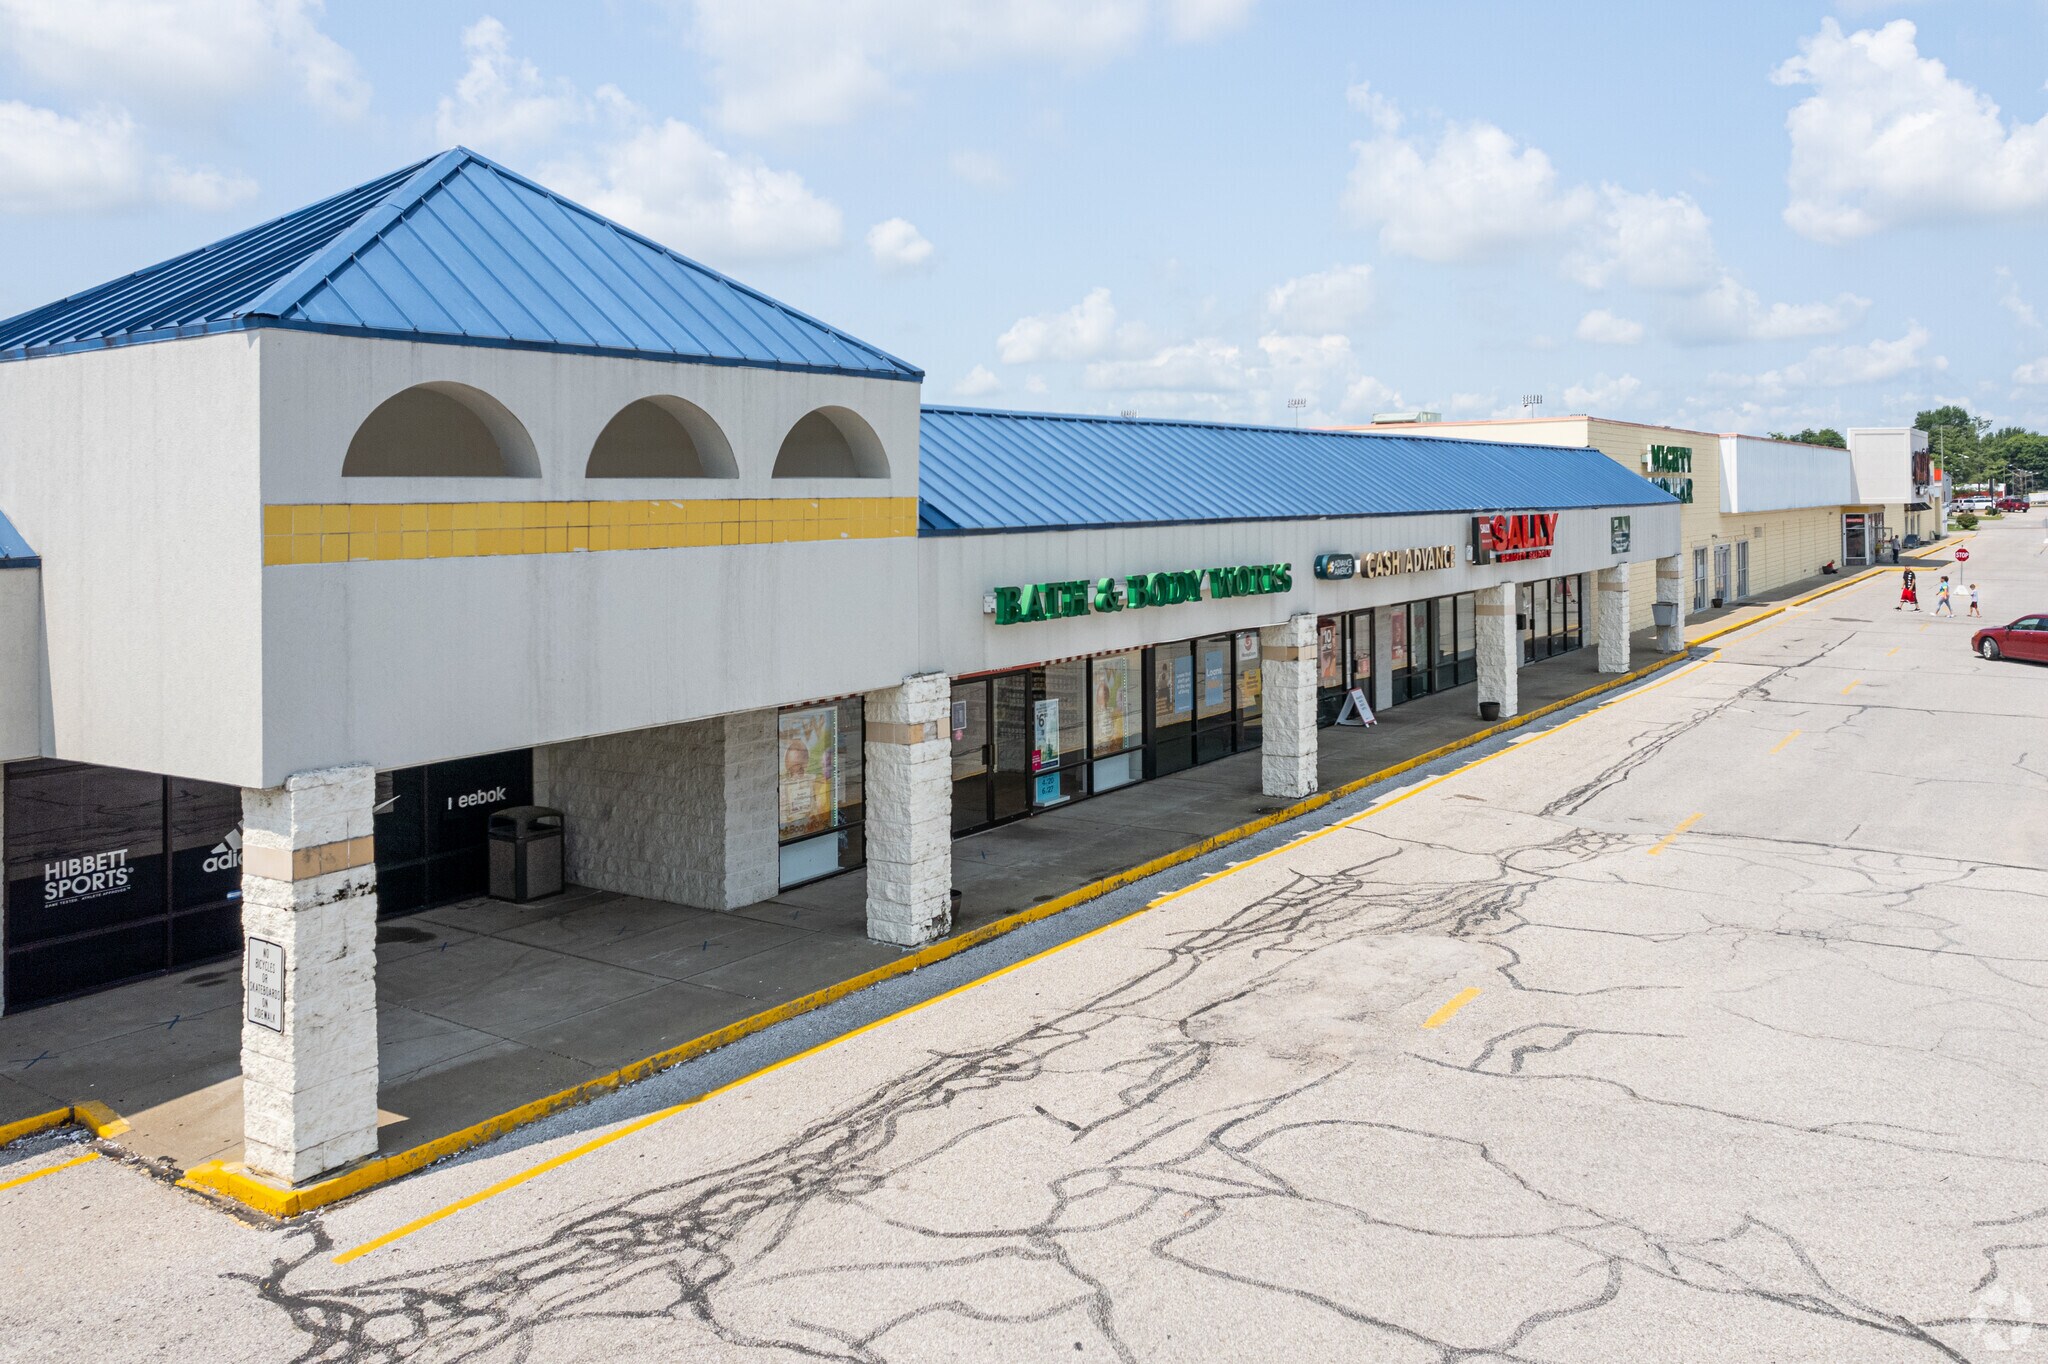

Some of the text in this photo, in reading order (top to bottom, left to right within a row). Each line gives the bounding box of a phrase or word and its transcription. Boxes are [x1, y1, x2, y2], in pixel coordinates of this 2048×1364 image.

[1491, 513, 1558, 551] SALLY
[1361, 545, 1455, 578] CASH ADVANCE
[1955, 550, 1969, 558] STOP
[994, 563, 1292, 625] BATH & BODY WORKS
[45, 848, 128, 882] HIBBETT
[44, 867, 128, 900] SPORTS
[255, 958, 275, 973] BICYCLES
[249, 981, 280, 1000] SKATEBOARDS
[254, 1007, 275, 1023] SIDEWALK
